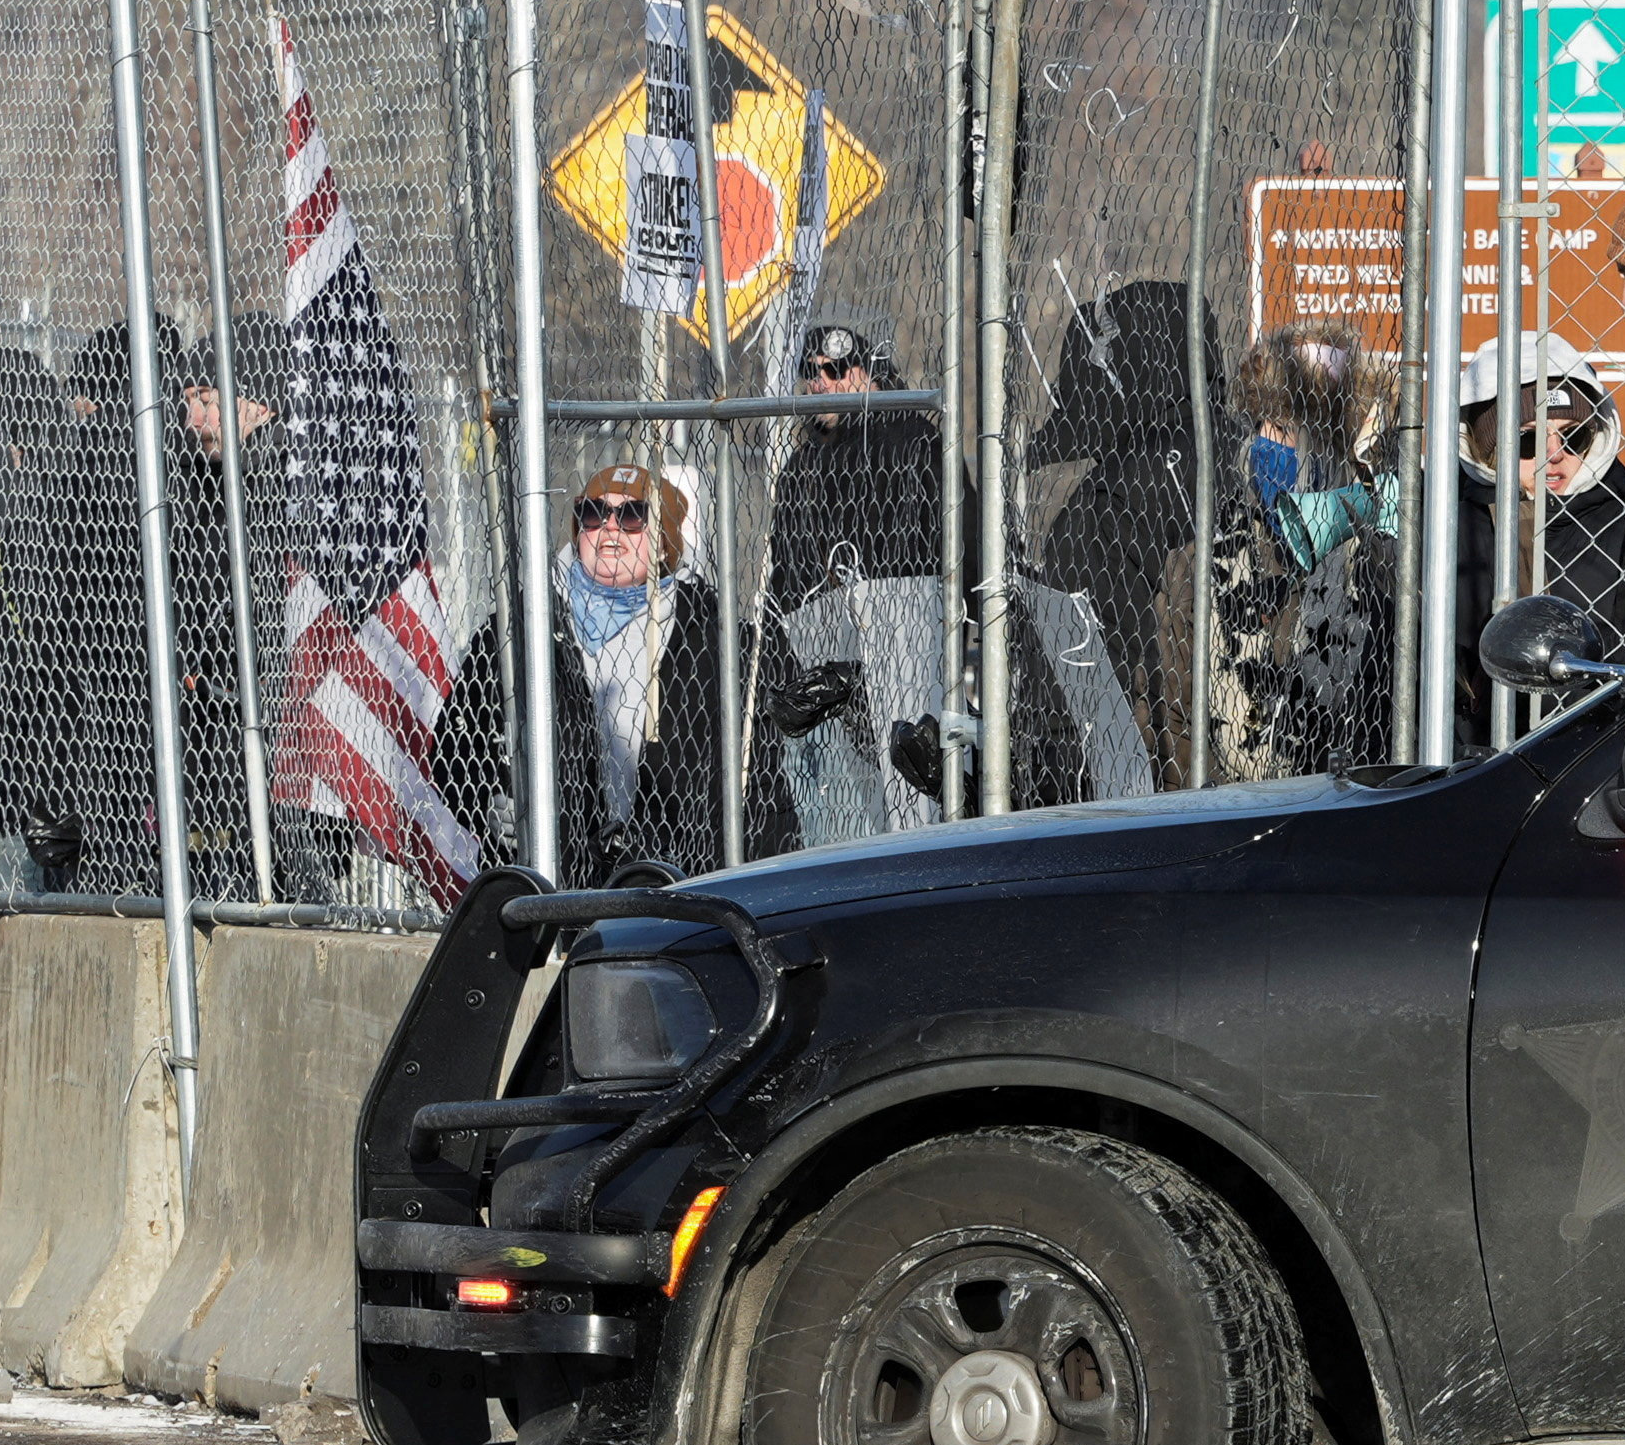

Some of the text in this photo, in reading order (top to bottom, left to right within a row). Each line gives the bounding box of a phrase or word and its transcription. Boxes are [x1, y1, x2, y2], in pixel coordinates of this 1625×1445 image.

[645, 82, 696, 143] ENERAL
[640, 172, 691, 230] STRIKE!
[1474, 228, 1530, 250] BAE
[1294, 264, 1351, 285] FRED
[1356, 264, 1403, 285] WEL
[1294, 293, 1403, 314] EDUCATIO
